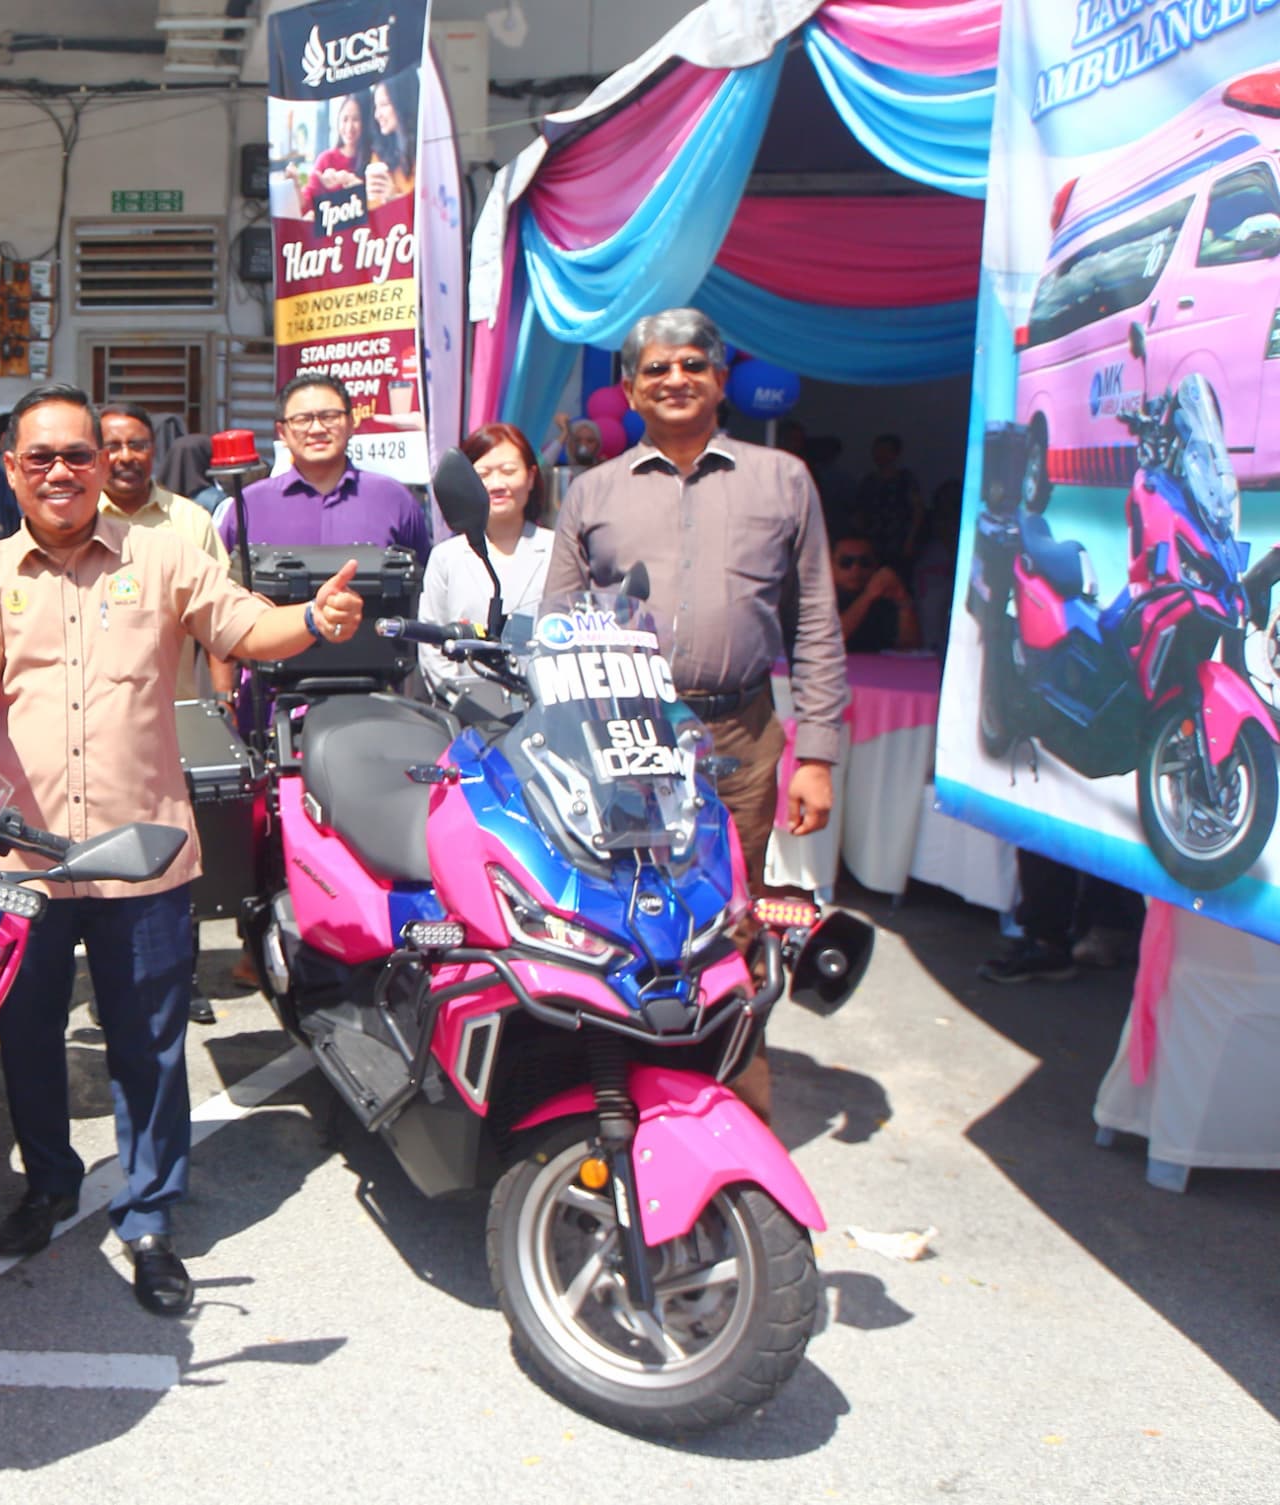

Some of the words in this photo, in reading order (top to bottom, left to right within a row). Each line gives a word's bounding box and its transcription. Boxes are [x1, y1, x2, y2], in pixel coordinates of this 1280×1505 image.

[325, 24, 391, 67] UCSI
[325, 56, 389, 83] University
[319, 194, 364, 236] Ipoh
[282, 236, 344, 283] Hari
[352, 223, 417, 284] Info
[294, 300, 309, 317] 30
[311, 287, 403, 313] NOVEMBER
[332, 304, 417, 328] DISEMBER
[301, 337, 391, 364] STARBUCKS
[330, 357, 399, 379] PARADE,
[368, 440, 407, 460] 4428
[575, 613, 618, 632] MK
[534, 651, 677, 707] MEDIC
[607, 719, 658, 748] SU
